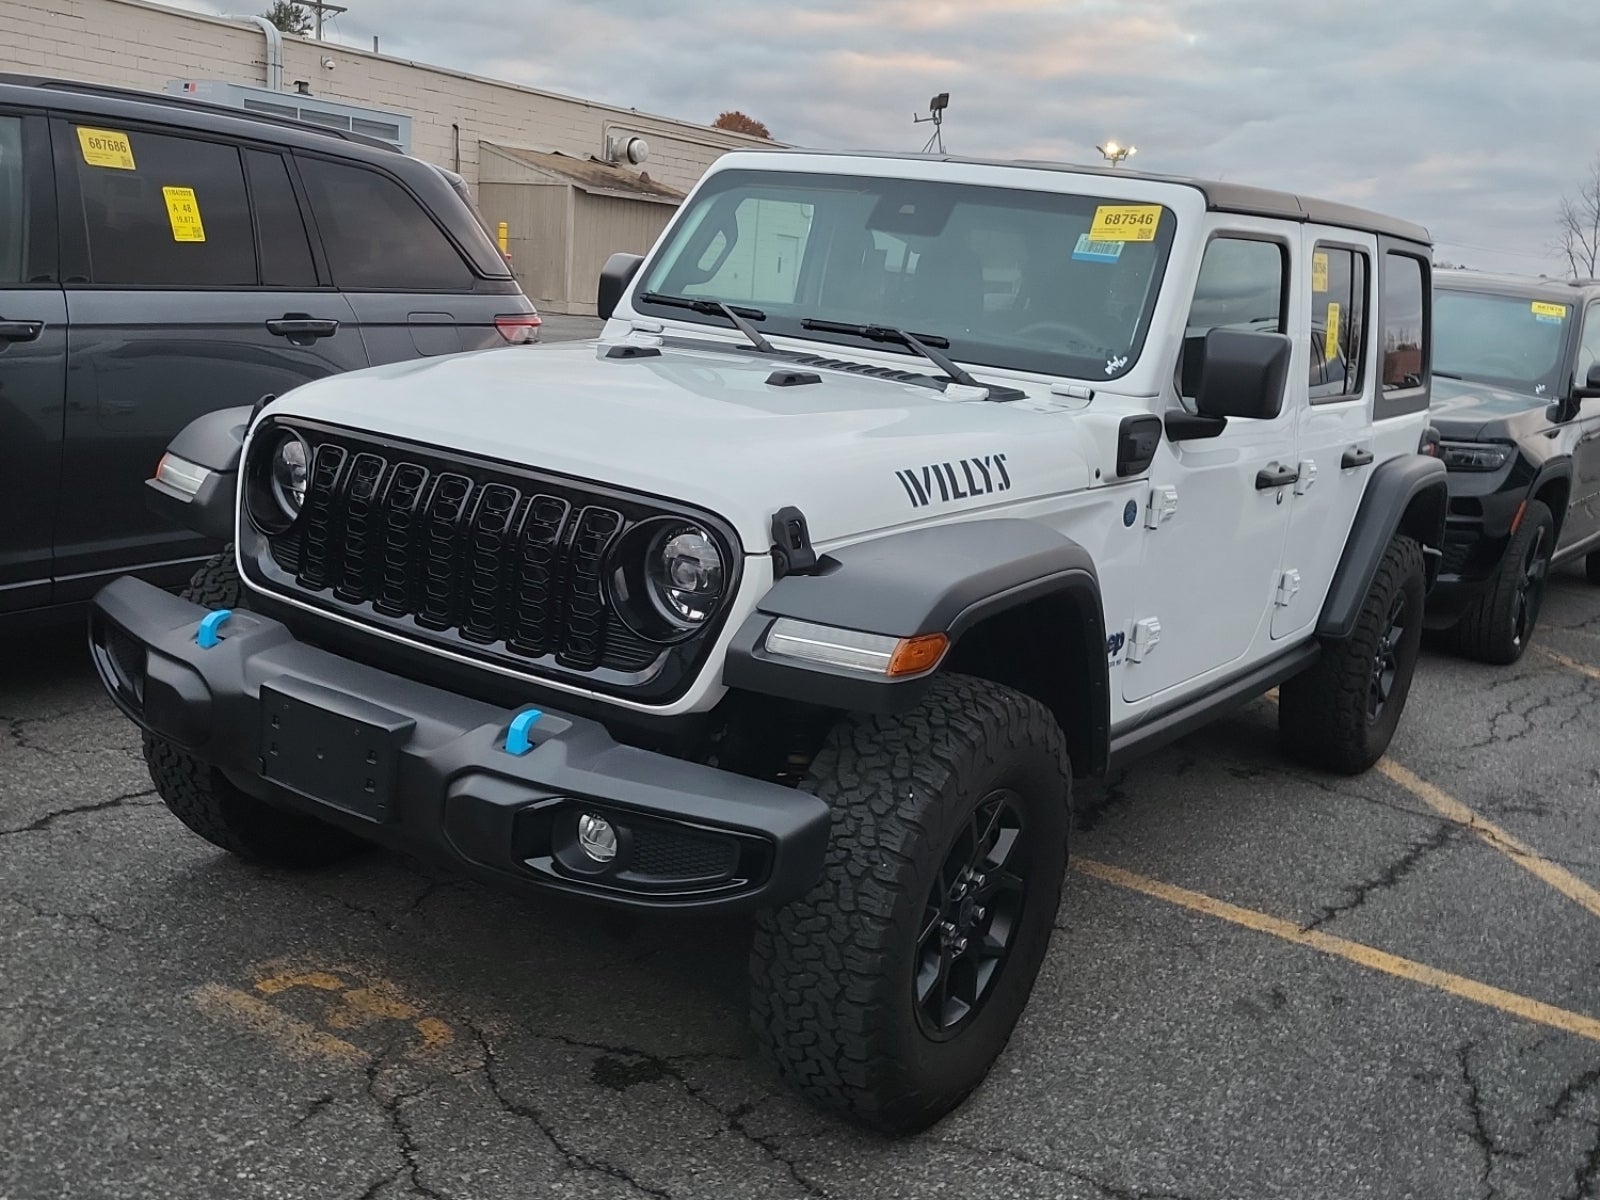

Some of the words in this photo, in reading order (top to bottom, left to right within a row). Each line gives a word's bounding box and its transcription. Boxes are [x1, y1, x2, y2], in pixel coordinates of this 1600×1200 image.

[88, 137, 127, 153] 687686
[172, 203, 179, 213] A
[182, 203, 192, 213] 48
[1104, 213, 1154, 225] 687546
[895, 453, 1011, 507] WILLYS
